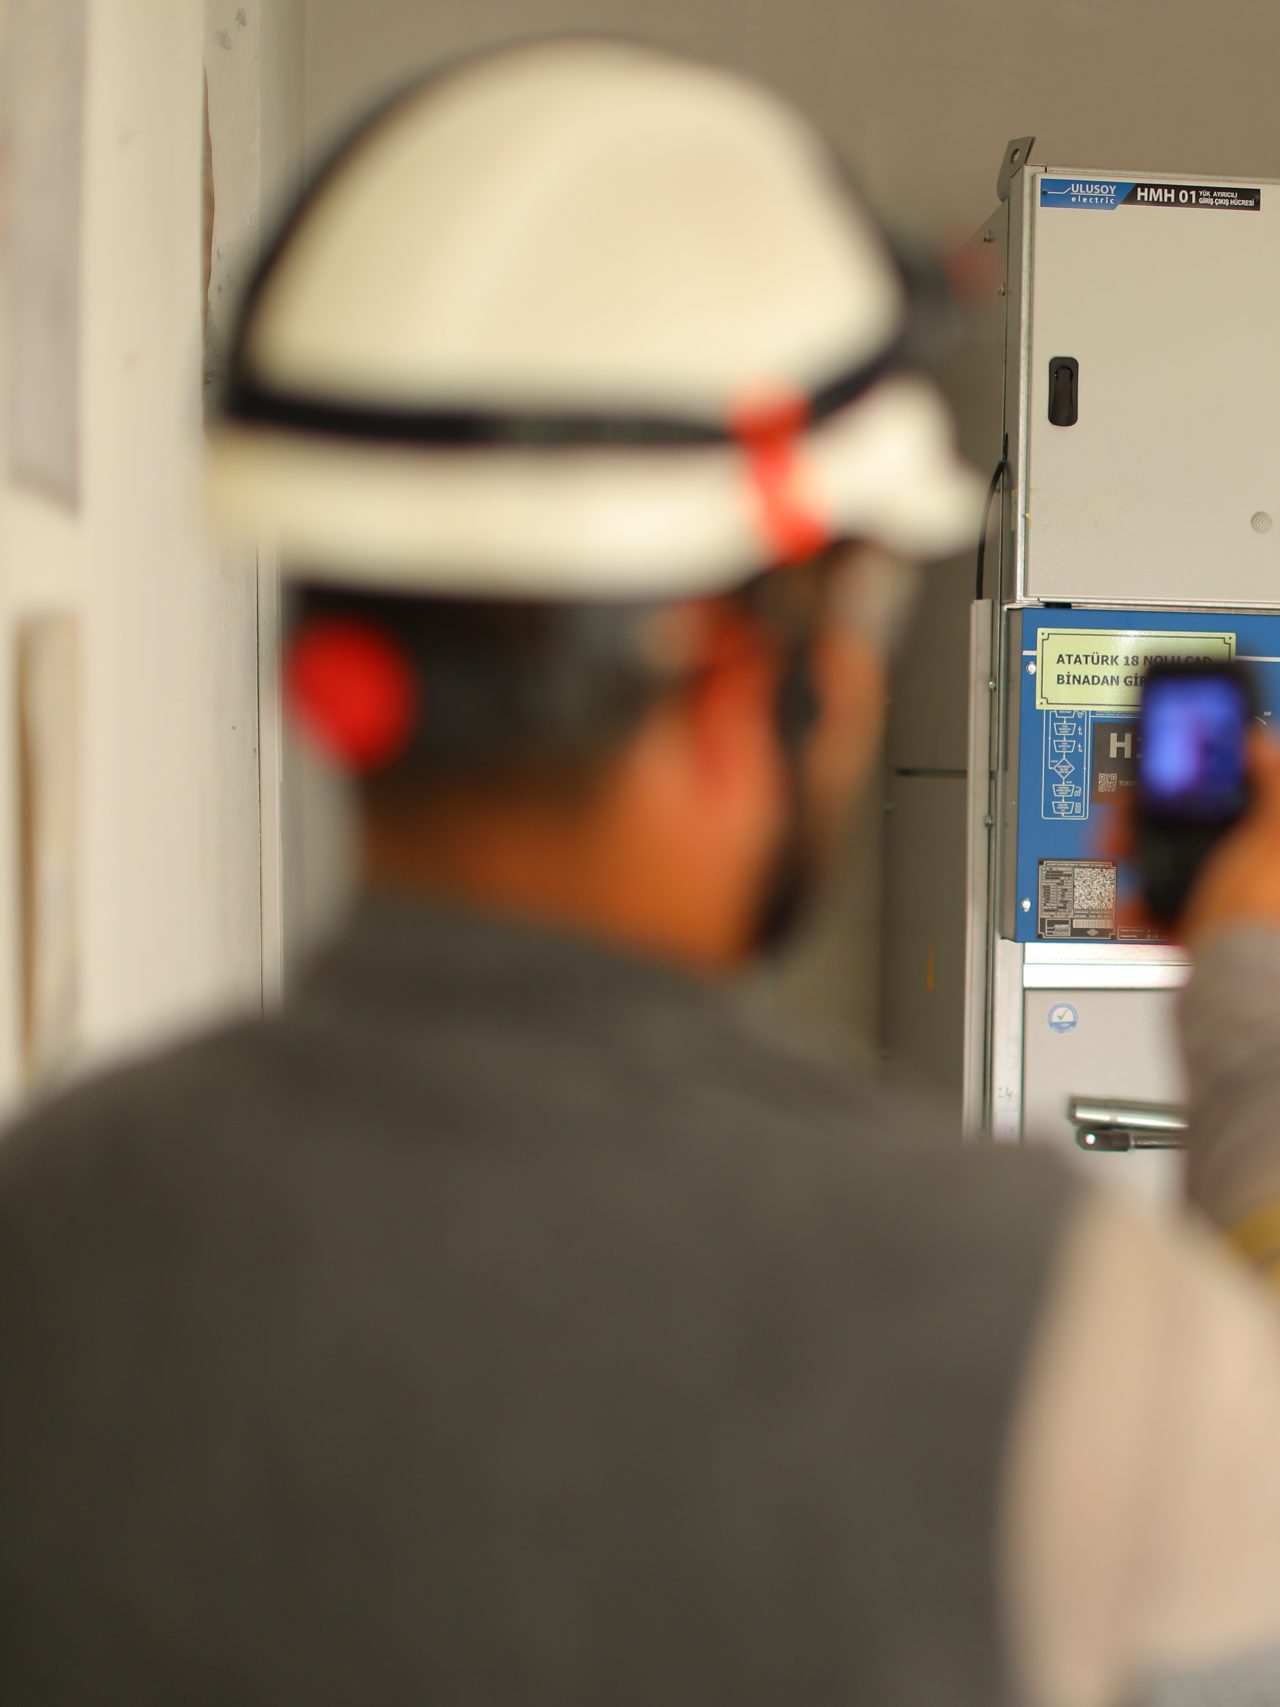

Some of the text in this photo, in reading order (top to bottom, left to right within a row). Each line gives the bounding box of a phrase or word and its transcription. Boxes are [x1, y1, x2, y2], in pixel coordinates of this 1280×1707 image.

[1071, 184, 1116, 195] ULUSOY
[1136, 187, 1197, 204] HMH 01
[1071, 195, 1115, 204] electric
[1056, 651, 1119, 666] ATATÜRK
[1123, 655, 1139, 667] 18
[1056, 672, 1119, 686] BİNADAN
